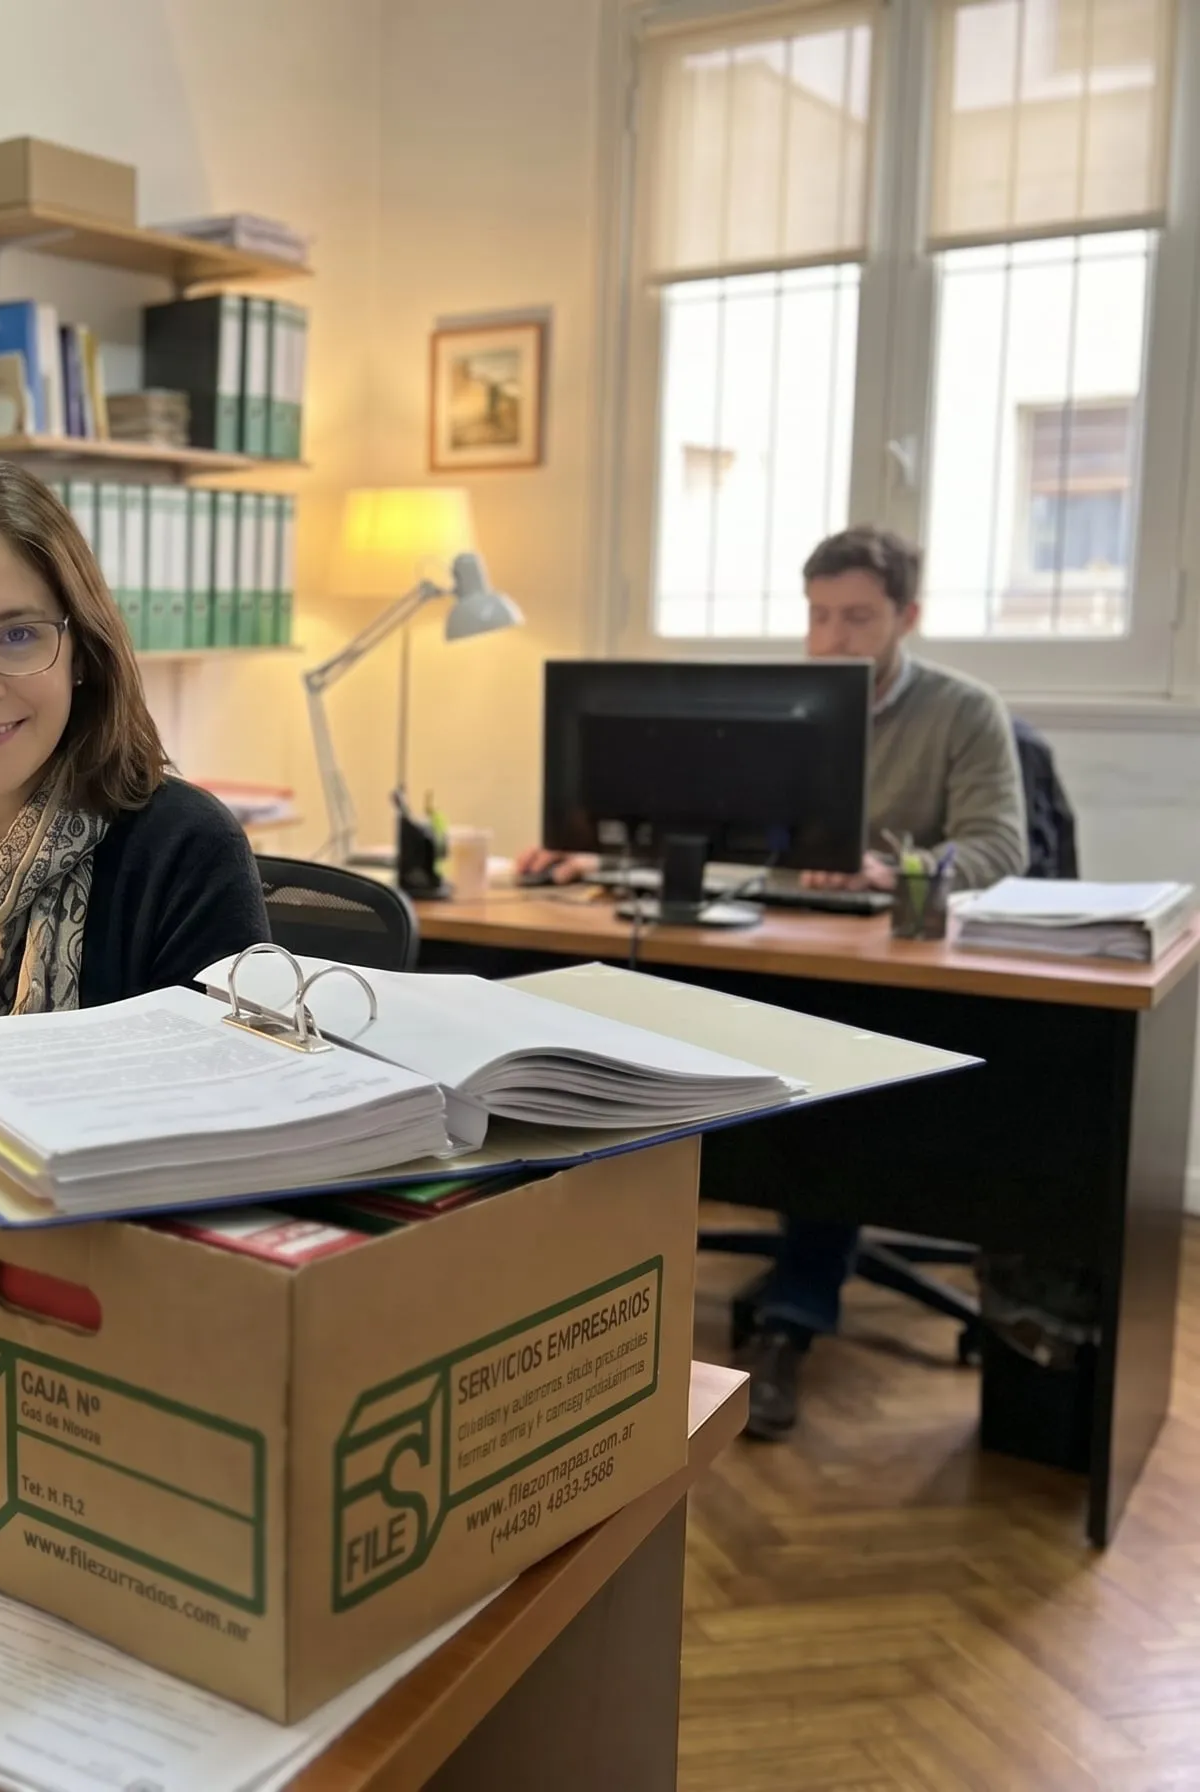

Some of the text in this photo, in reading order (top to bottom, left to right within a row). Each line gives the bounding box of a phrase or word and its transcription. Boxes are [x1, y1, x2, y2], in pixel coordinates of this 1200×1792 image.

[458, 1340, 542, 1405] SERVICIOS
[547, 1287, 649, 1362] EMPRESARIOS
[21, 1370, 70, 1410] CAJA
[346, 1512, 407, 1583] FILE
